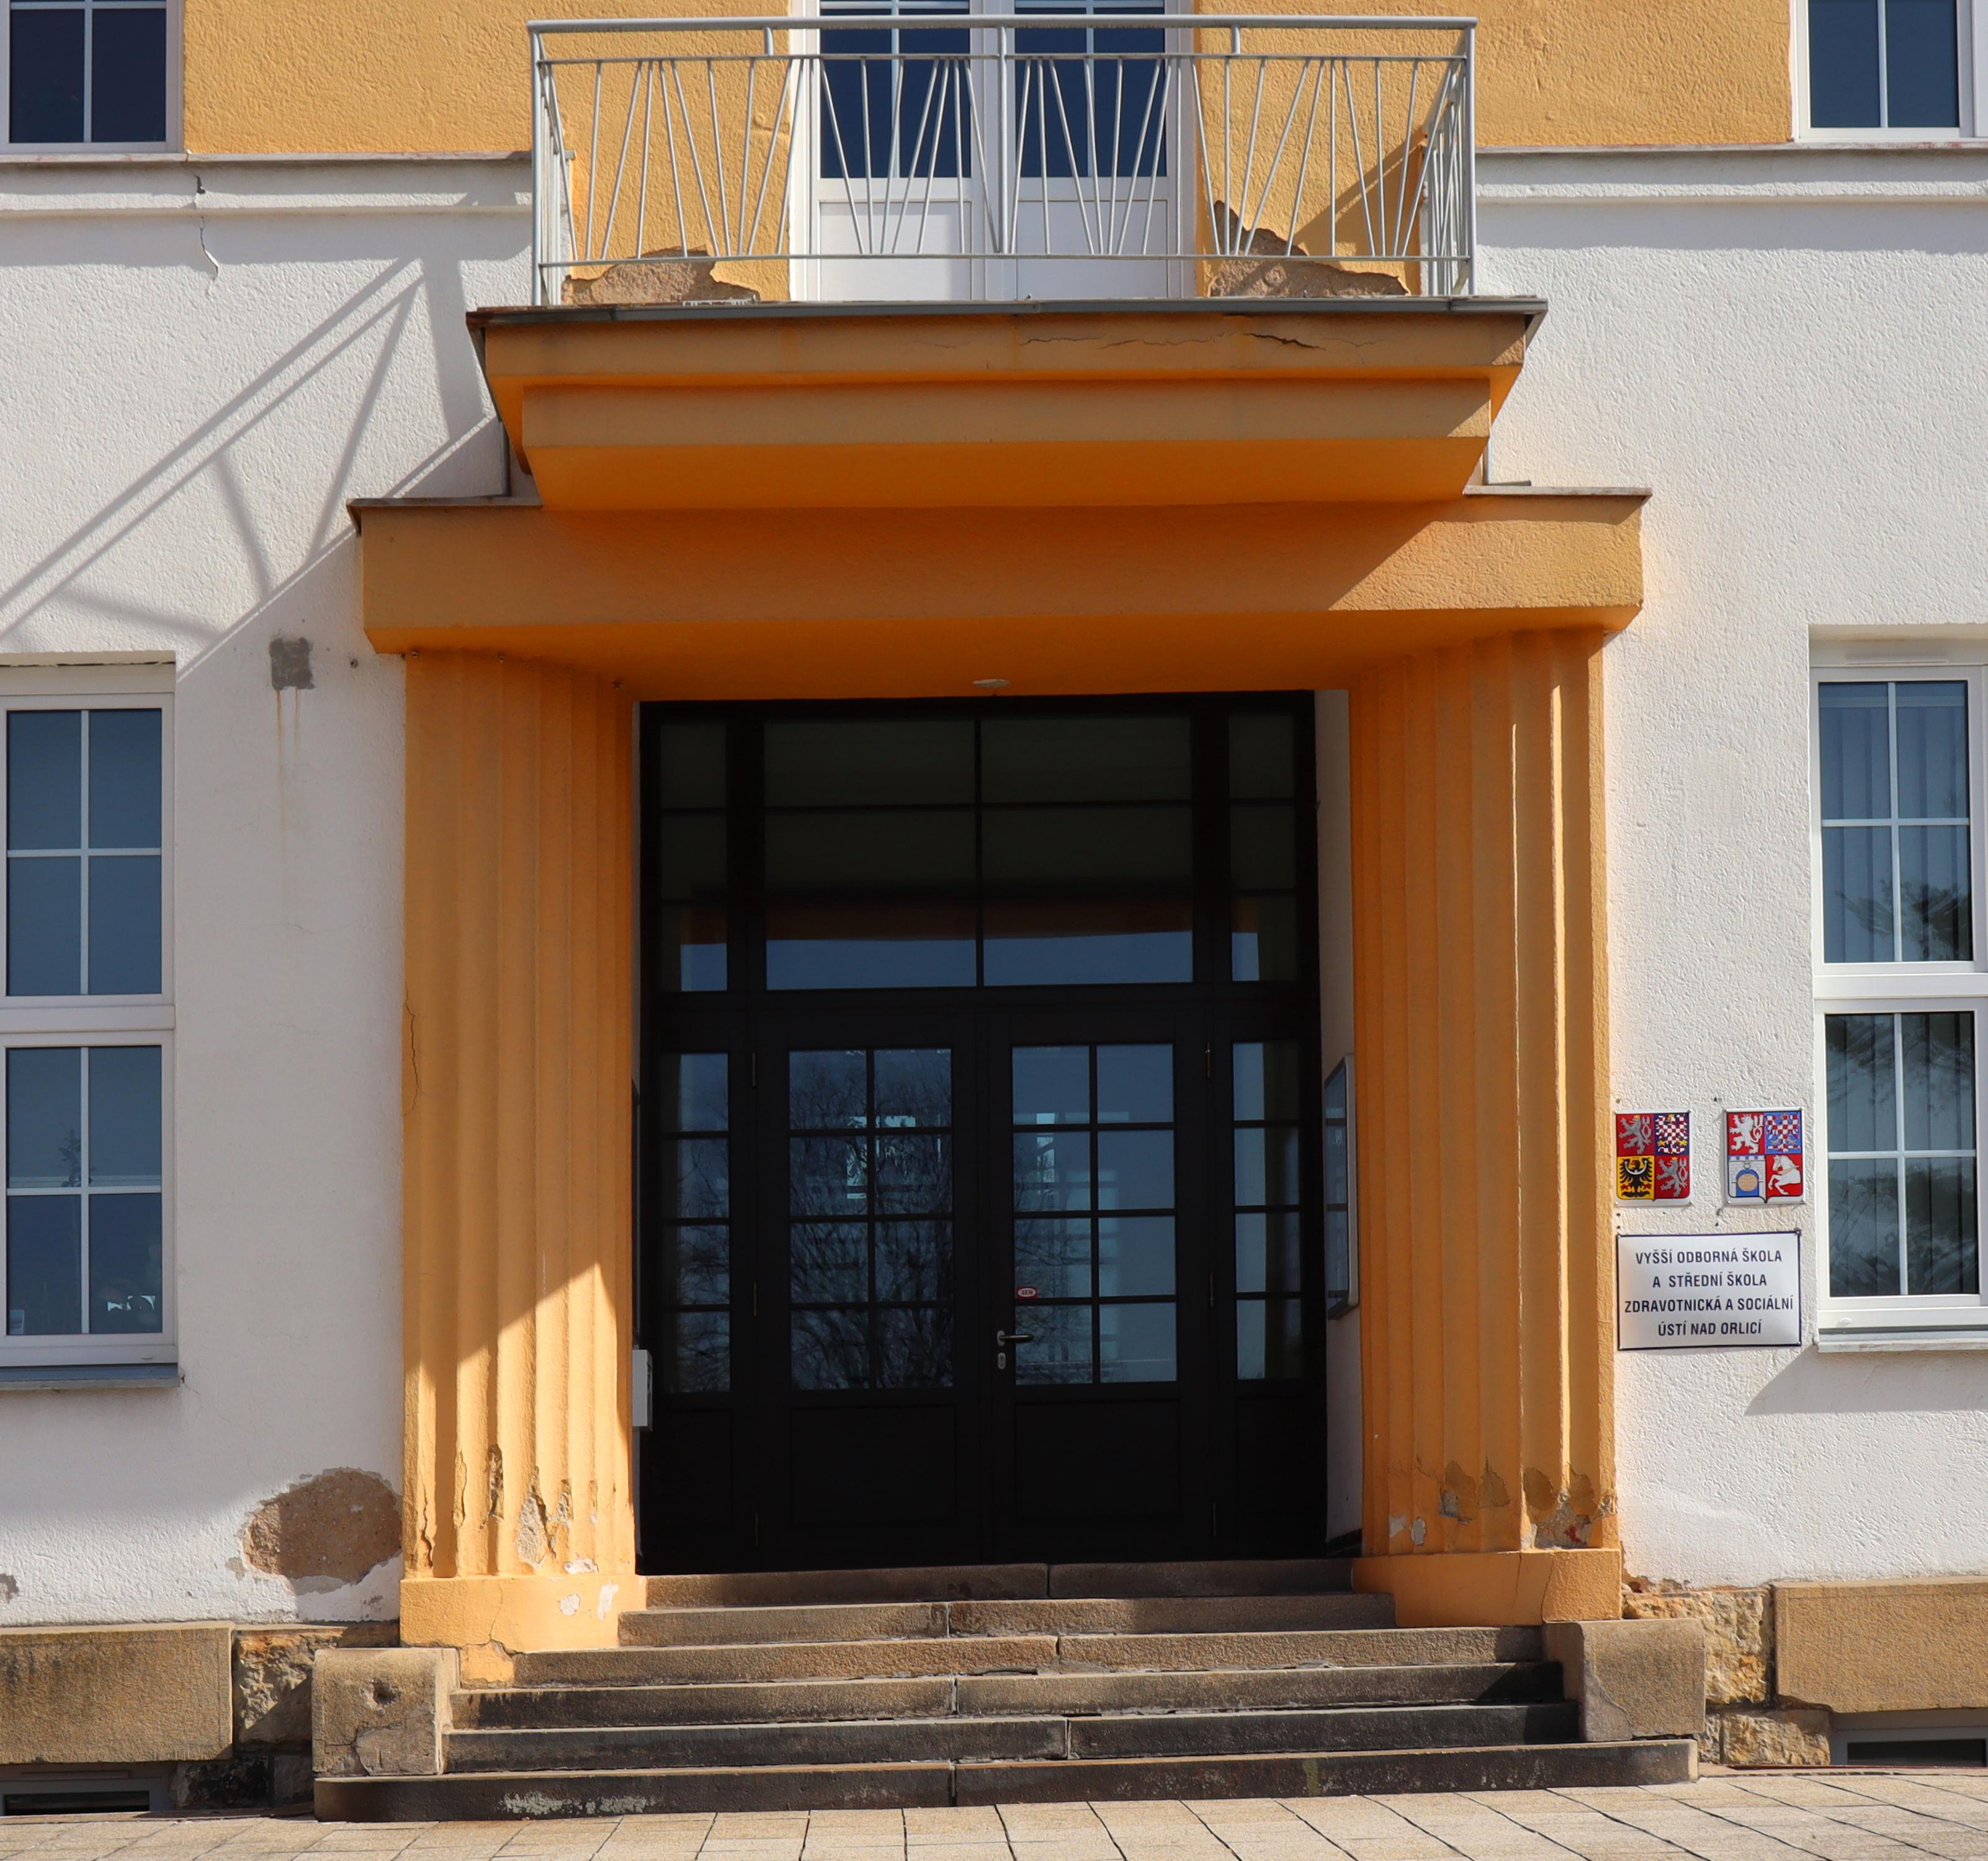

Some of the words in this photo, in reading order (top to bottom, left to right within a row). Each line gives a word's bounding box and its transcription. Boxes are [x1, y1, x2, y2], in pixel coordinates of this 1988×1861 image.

[1635, 1249, 1673, 1264] VYŠŠÍ
[1677, 1247, 1739, 1264] ODBORNÁ
[1742, 1247, 1783, 1262] ŠKOLA
[1652, 1275, 1662, 1288] A
[1668, 1272, 1723, 1288] STŘEDNÍ
[1727, 1270, 1767, 1287] ŠKOLA
[1624, 1295, 1722, 1313] ZDRAVOTNICKÁ
[1725, 1298, 1734, 1311] A
[1737, 1294, 1794, 1311] SOCIÁLNÍ
[1658, 1320, 1687, 1337] ÚSTÍ
[1690, 1323, 1717, 1336] NAD
[1721, 1318, 1762, 1334] ORLICÍ
